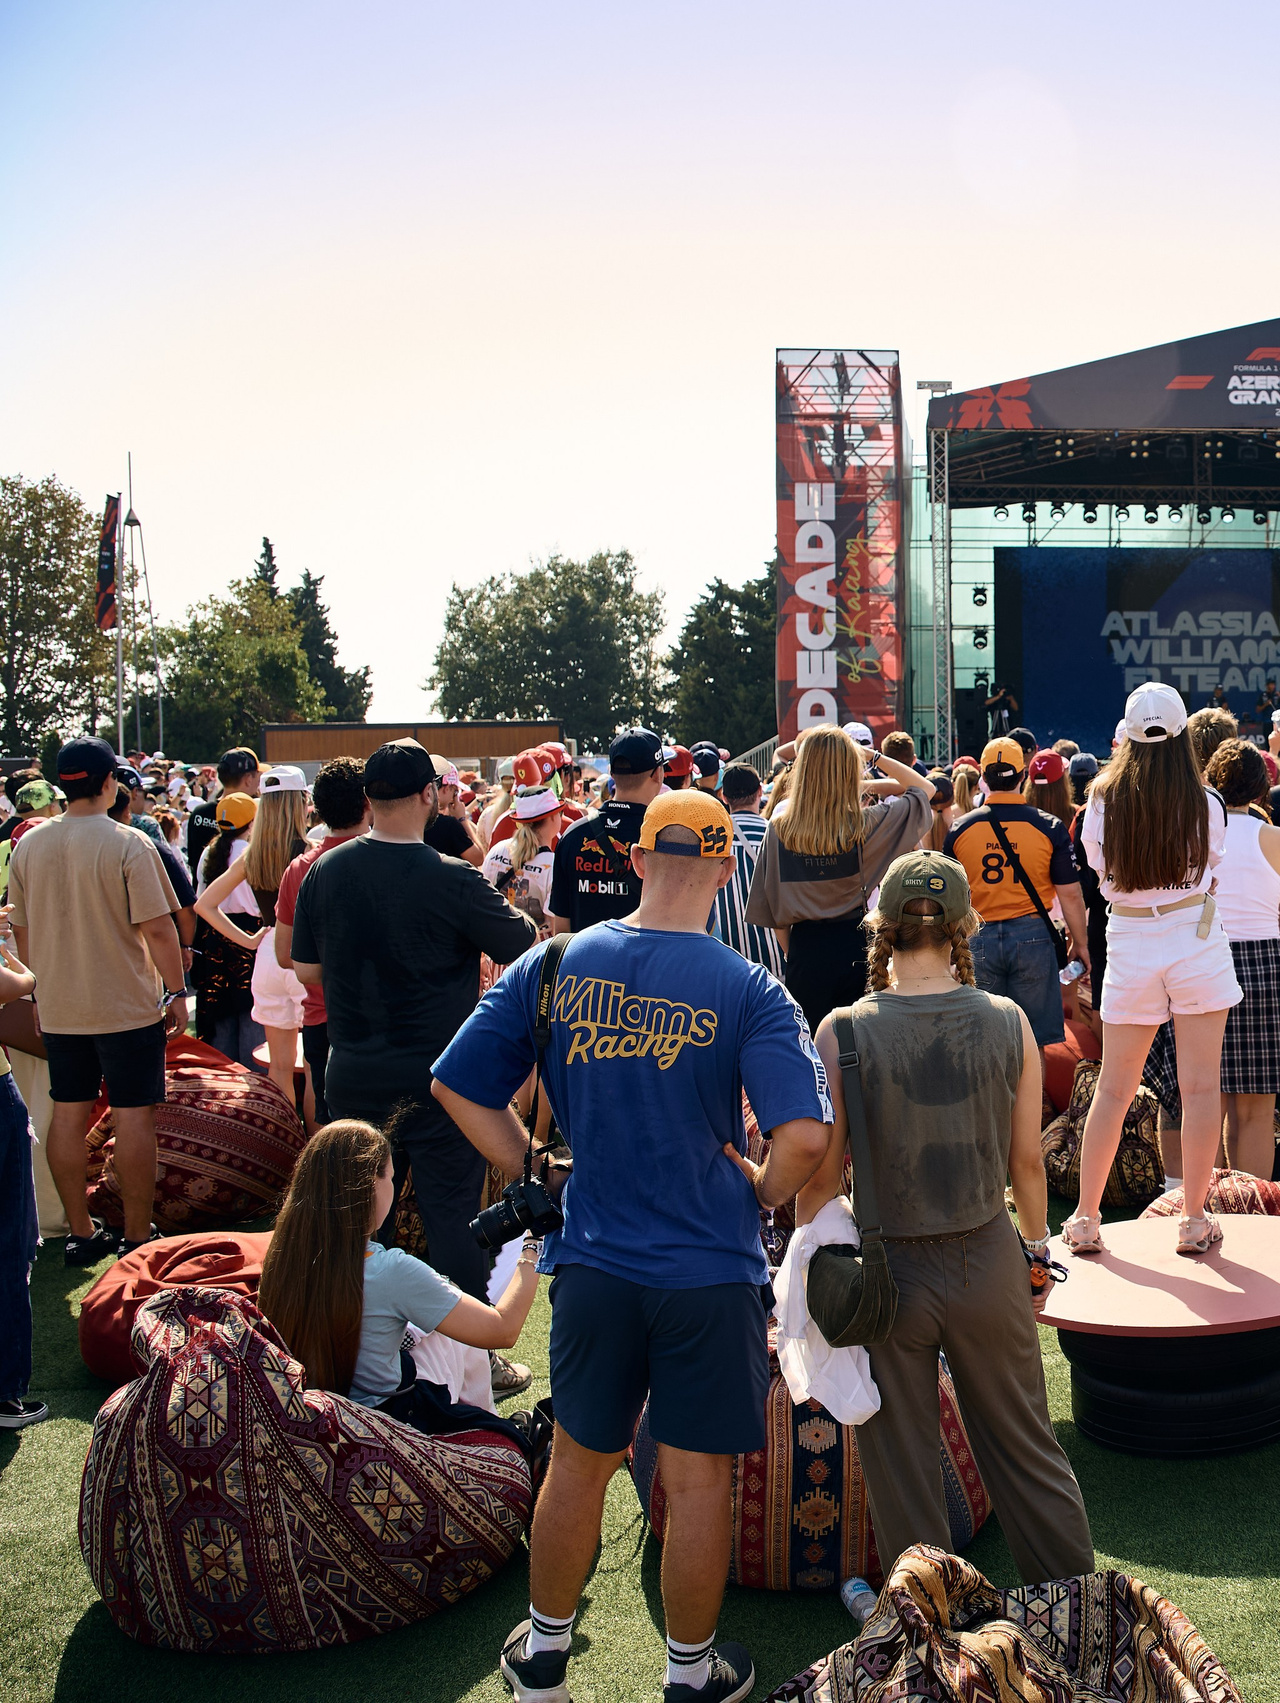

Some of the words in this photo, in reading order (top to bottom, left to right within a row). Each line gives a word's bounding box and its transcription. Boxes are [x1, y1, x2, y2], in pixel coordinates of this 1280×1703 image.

[1233, 364, 1272, 372] FORMULA
[822, 531, 897, 639] Racing
[794, 482, 838, 732] DECADE
[575, 855, 604, 871] Red
[804, 858, 813, 867] F1
[815, 857, 838, 867] TEAM
[981, 853, 1020, 884] 81
[578, 879, 615, 894] Mobil
[929, 878, 945, 890] 3
[539, 983, 551, 1017] Nikon
[566, 1020, 689, 1071] Racing
[814, 1061, 827, 1095] PUM
